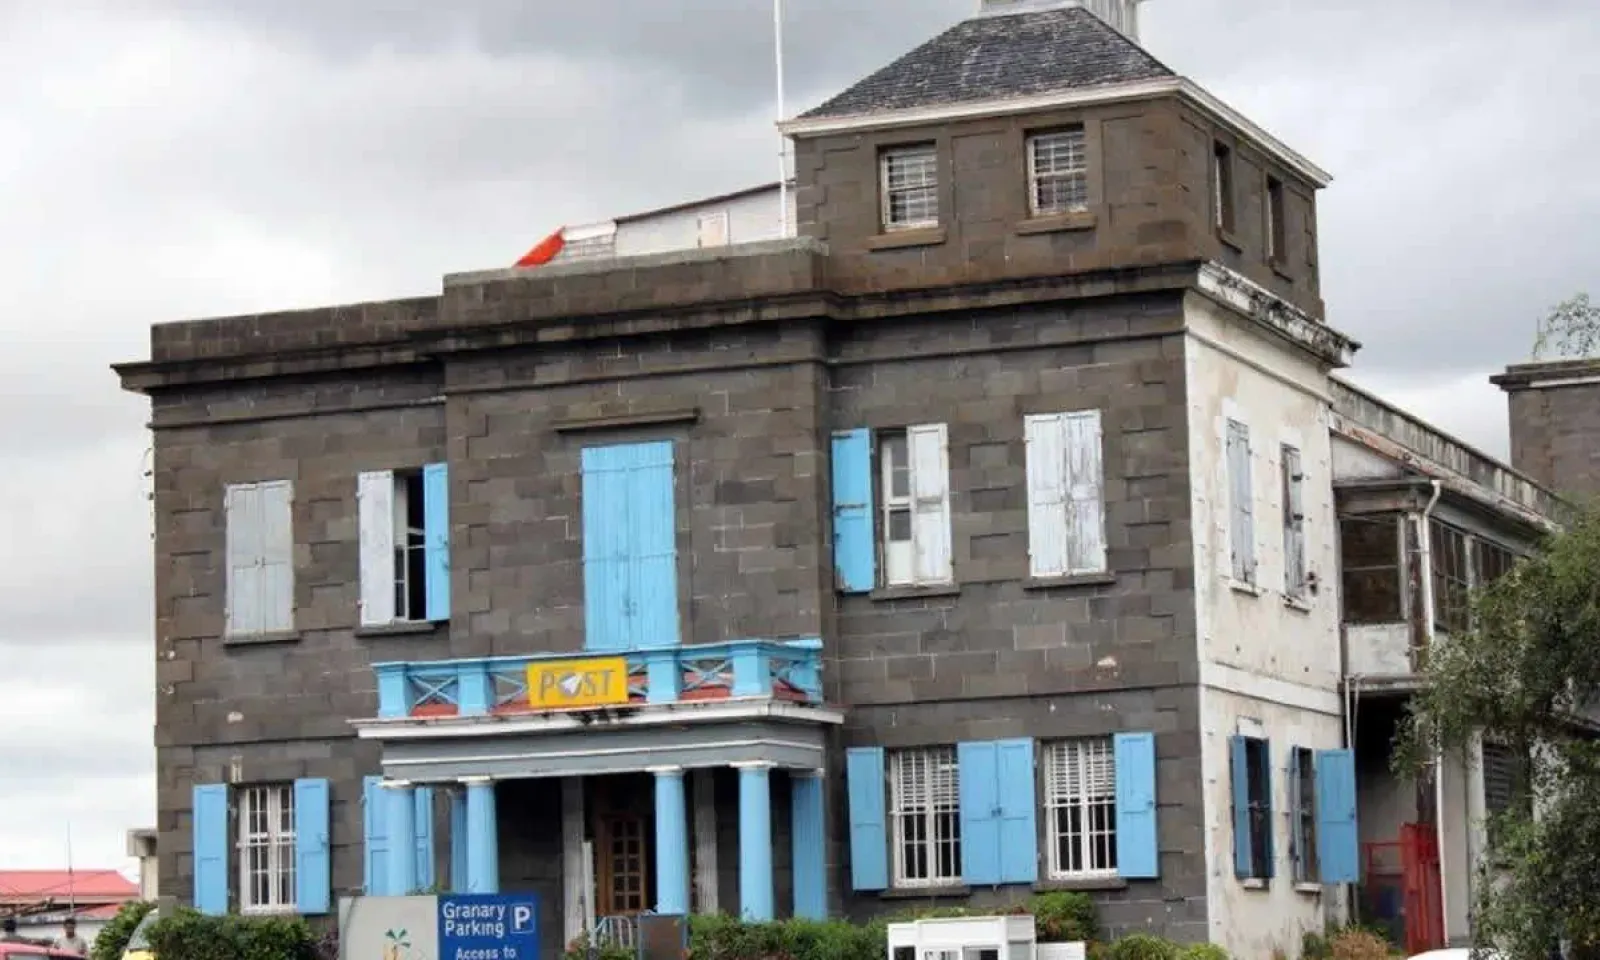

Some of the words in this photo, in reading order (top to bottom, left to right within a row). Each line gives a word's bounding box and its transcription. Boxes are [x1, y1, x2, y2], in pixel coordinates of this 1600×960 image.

[540, 669, 616, 701] POST
[442, 902, 506, 921] Granary
[514, 906, 531, 930] P
[445, 920, 505, 938] Parking
[456, 946, 499, 960] Access
[503, 945, 516, 959] to
